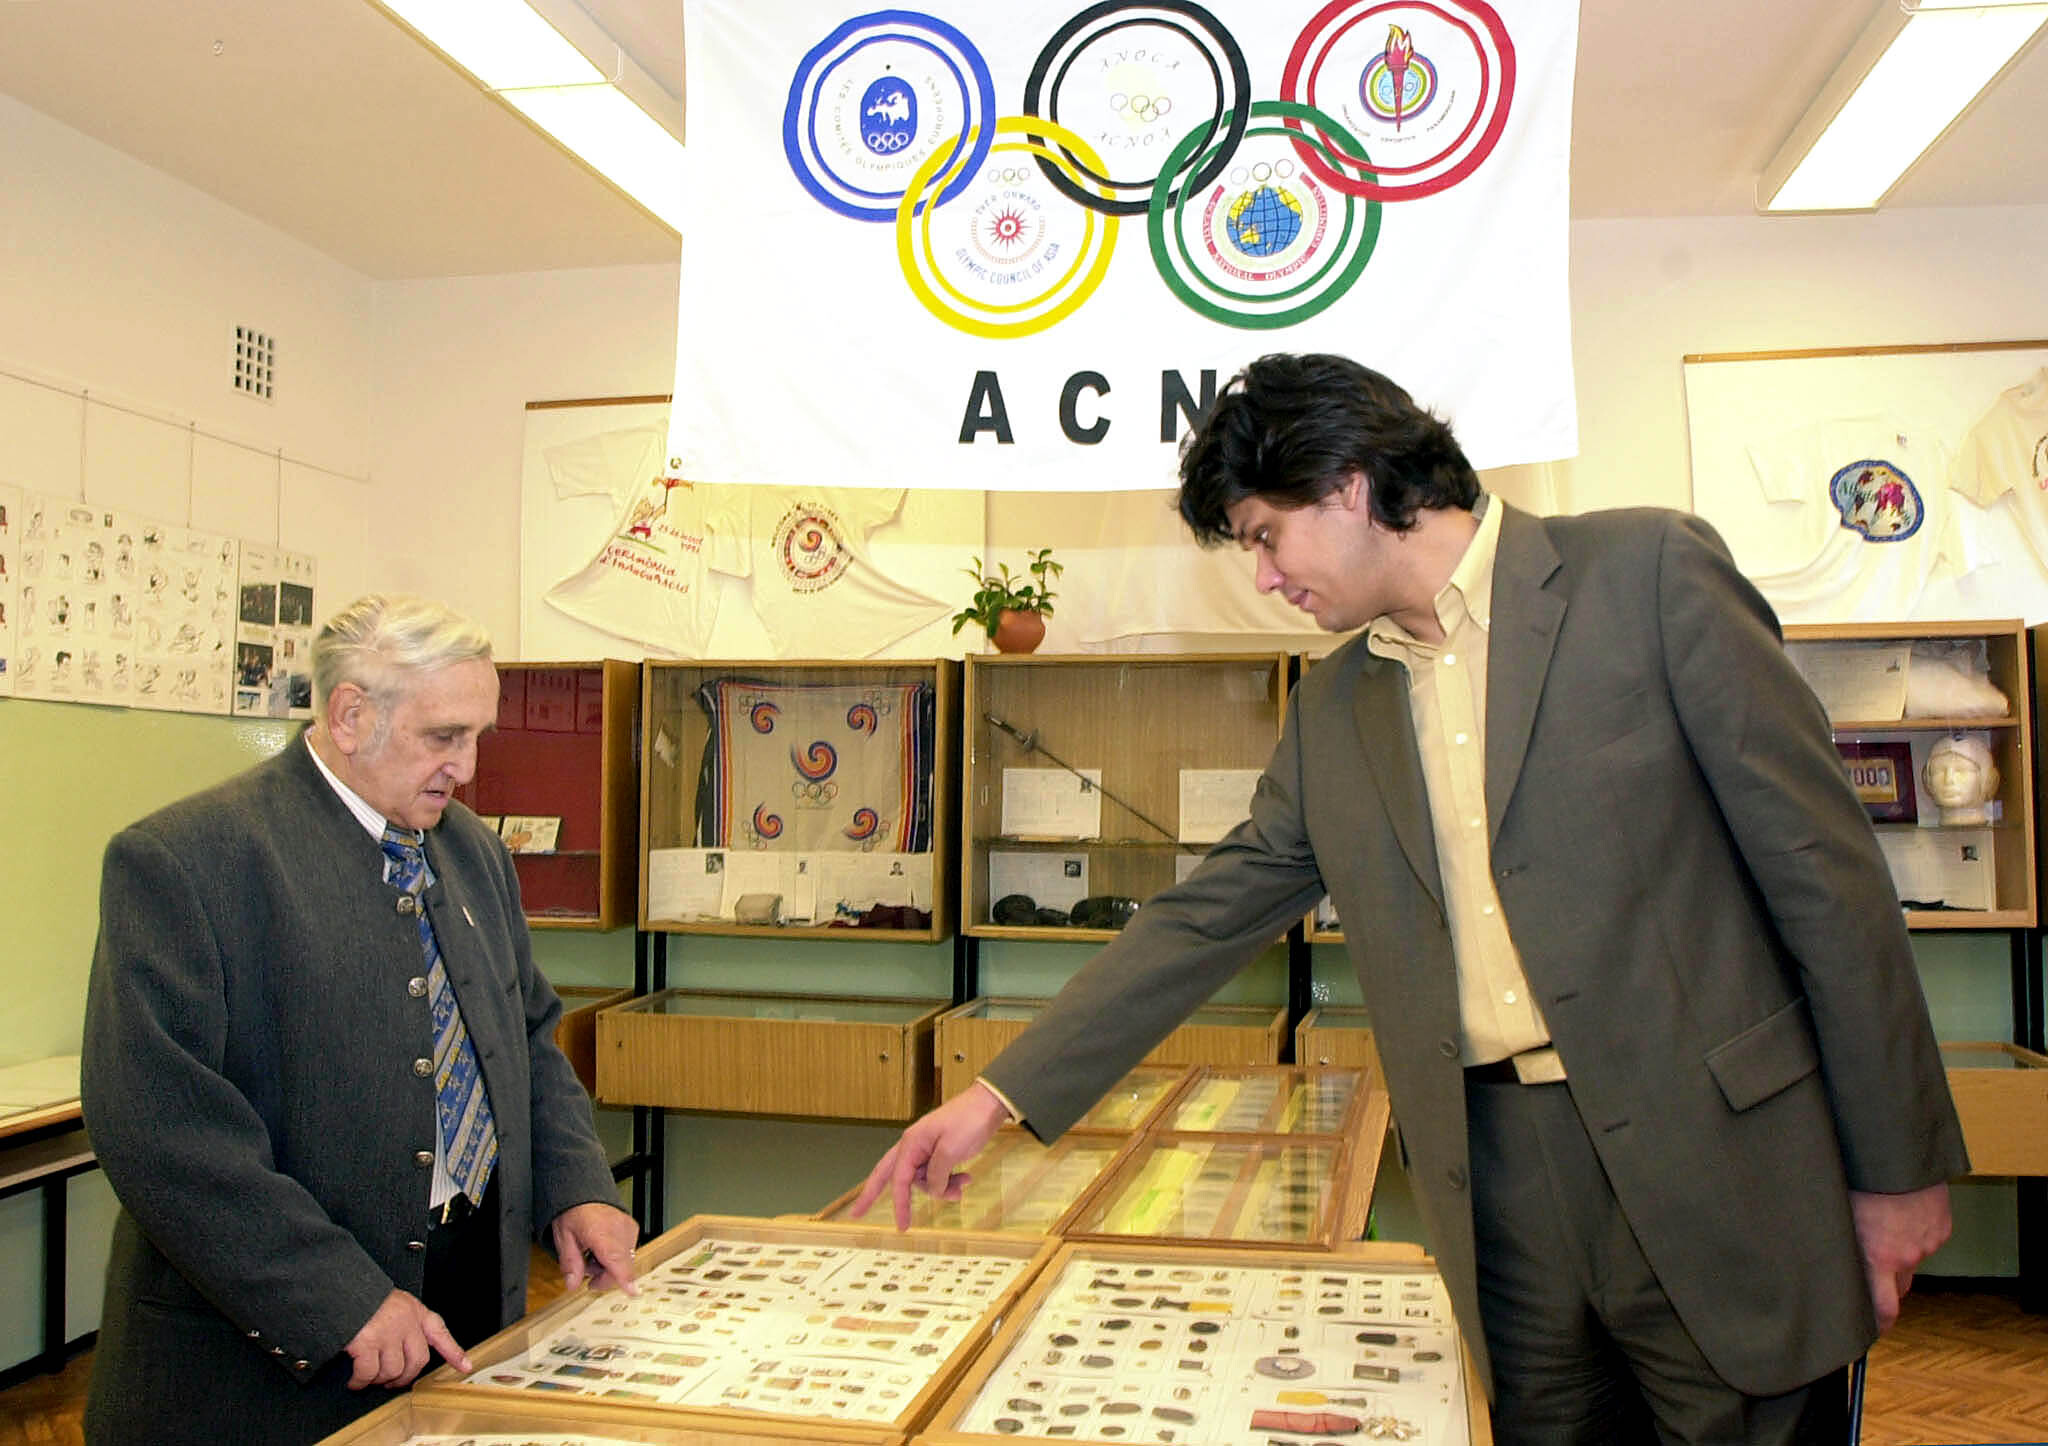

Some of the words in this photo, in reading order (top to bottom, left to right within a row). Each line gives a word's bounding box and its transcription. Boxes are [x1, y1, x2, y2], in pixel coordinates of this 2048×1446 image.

[1100, 48, 1181, 72] ANOCA
[955, 248, 988, 281] OLYMPIC
[989, 269, 1032, 285] COUNCIL
